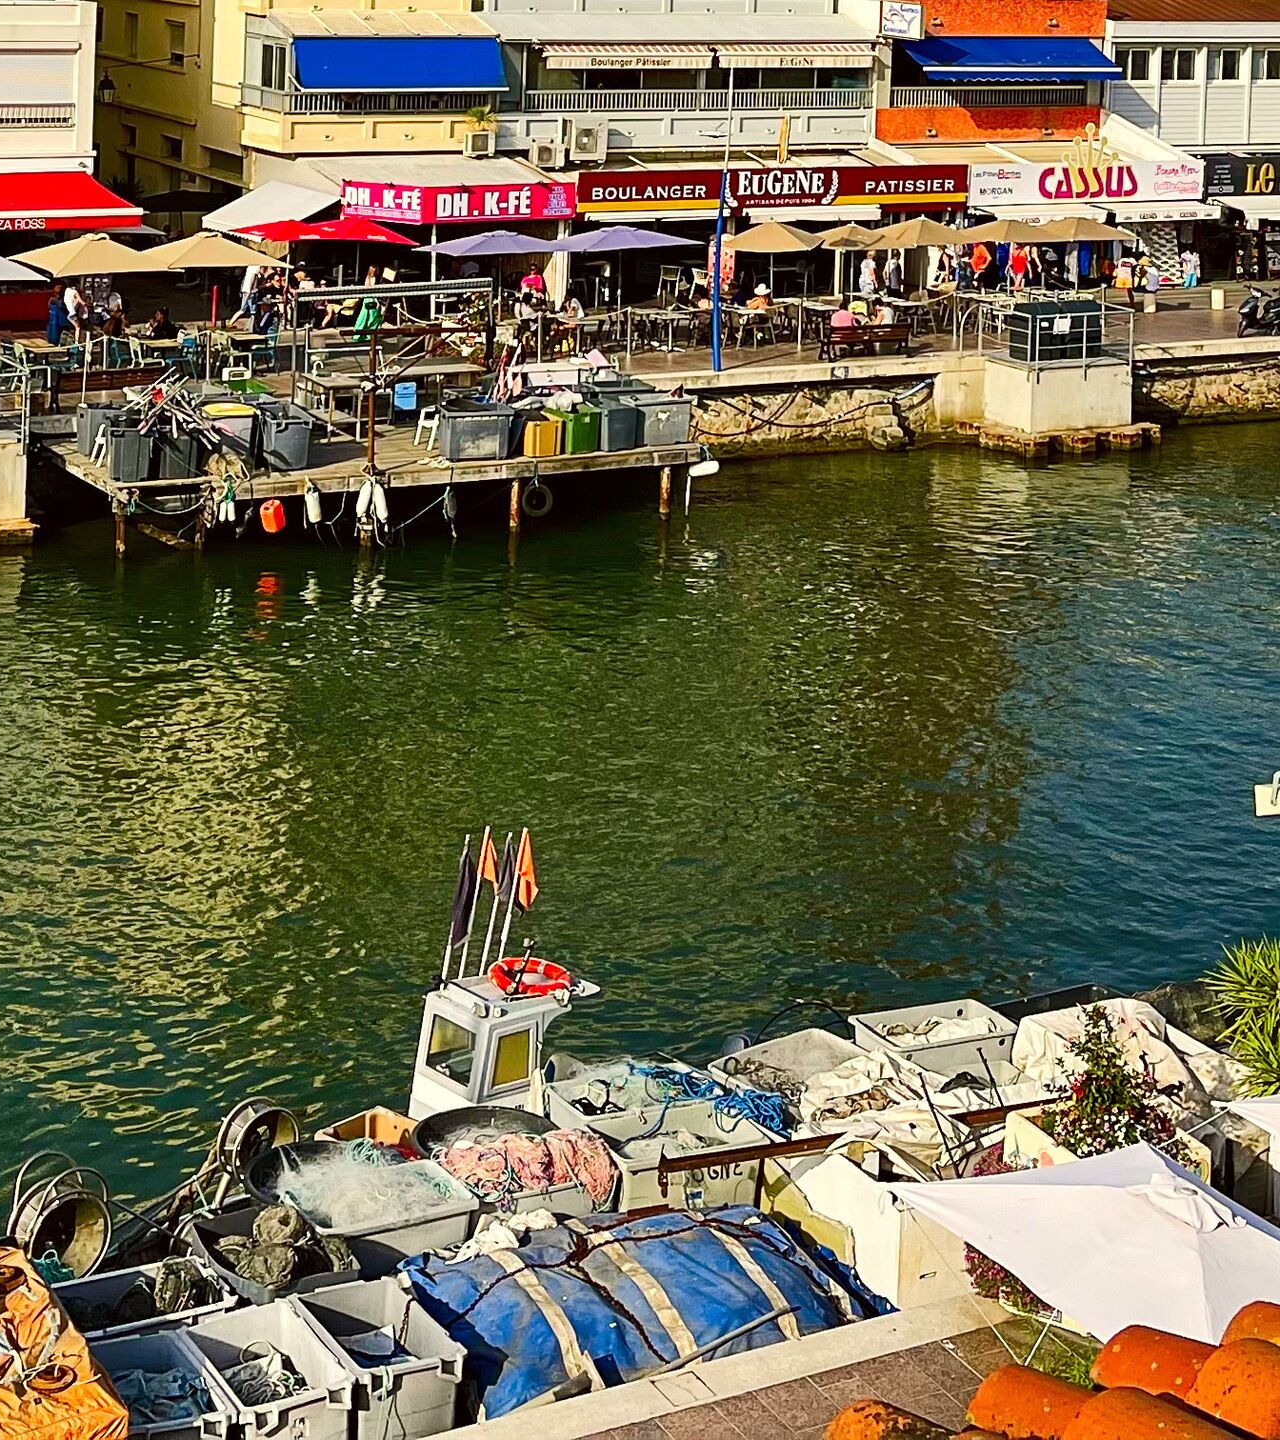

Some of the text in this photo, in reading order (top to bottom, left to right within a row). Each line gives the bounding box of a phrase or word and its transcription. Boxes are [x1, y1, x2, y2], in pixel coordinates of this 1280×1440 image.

[590, 57, 632, 68] Boulanger
[864, 179, 955, 194] PATISSIER
[1038, 165, 1138, 199] CASSUS
[591, 185, 707, 201] BOULANGER
[484, 186, 532, 216] K-FÉ
[14, 218, 46, 230] ROSS
